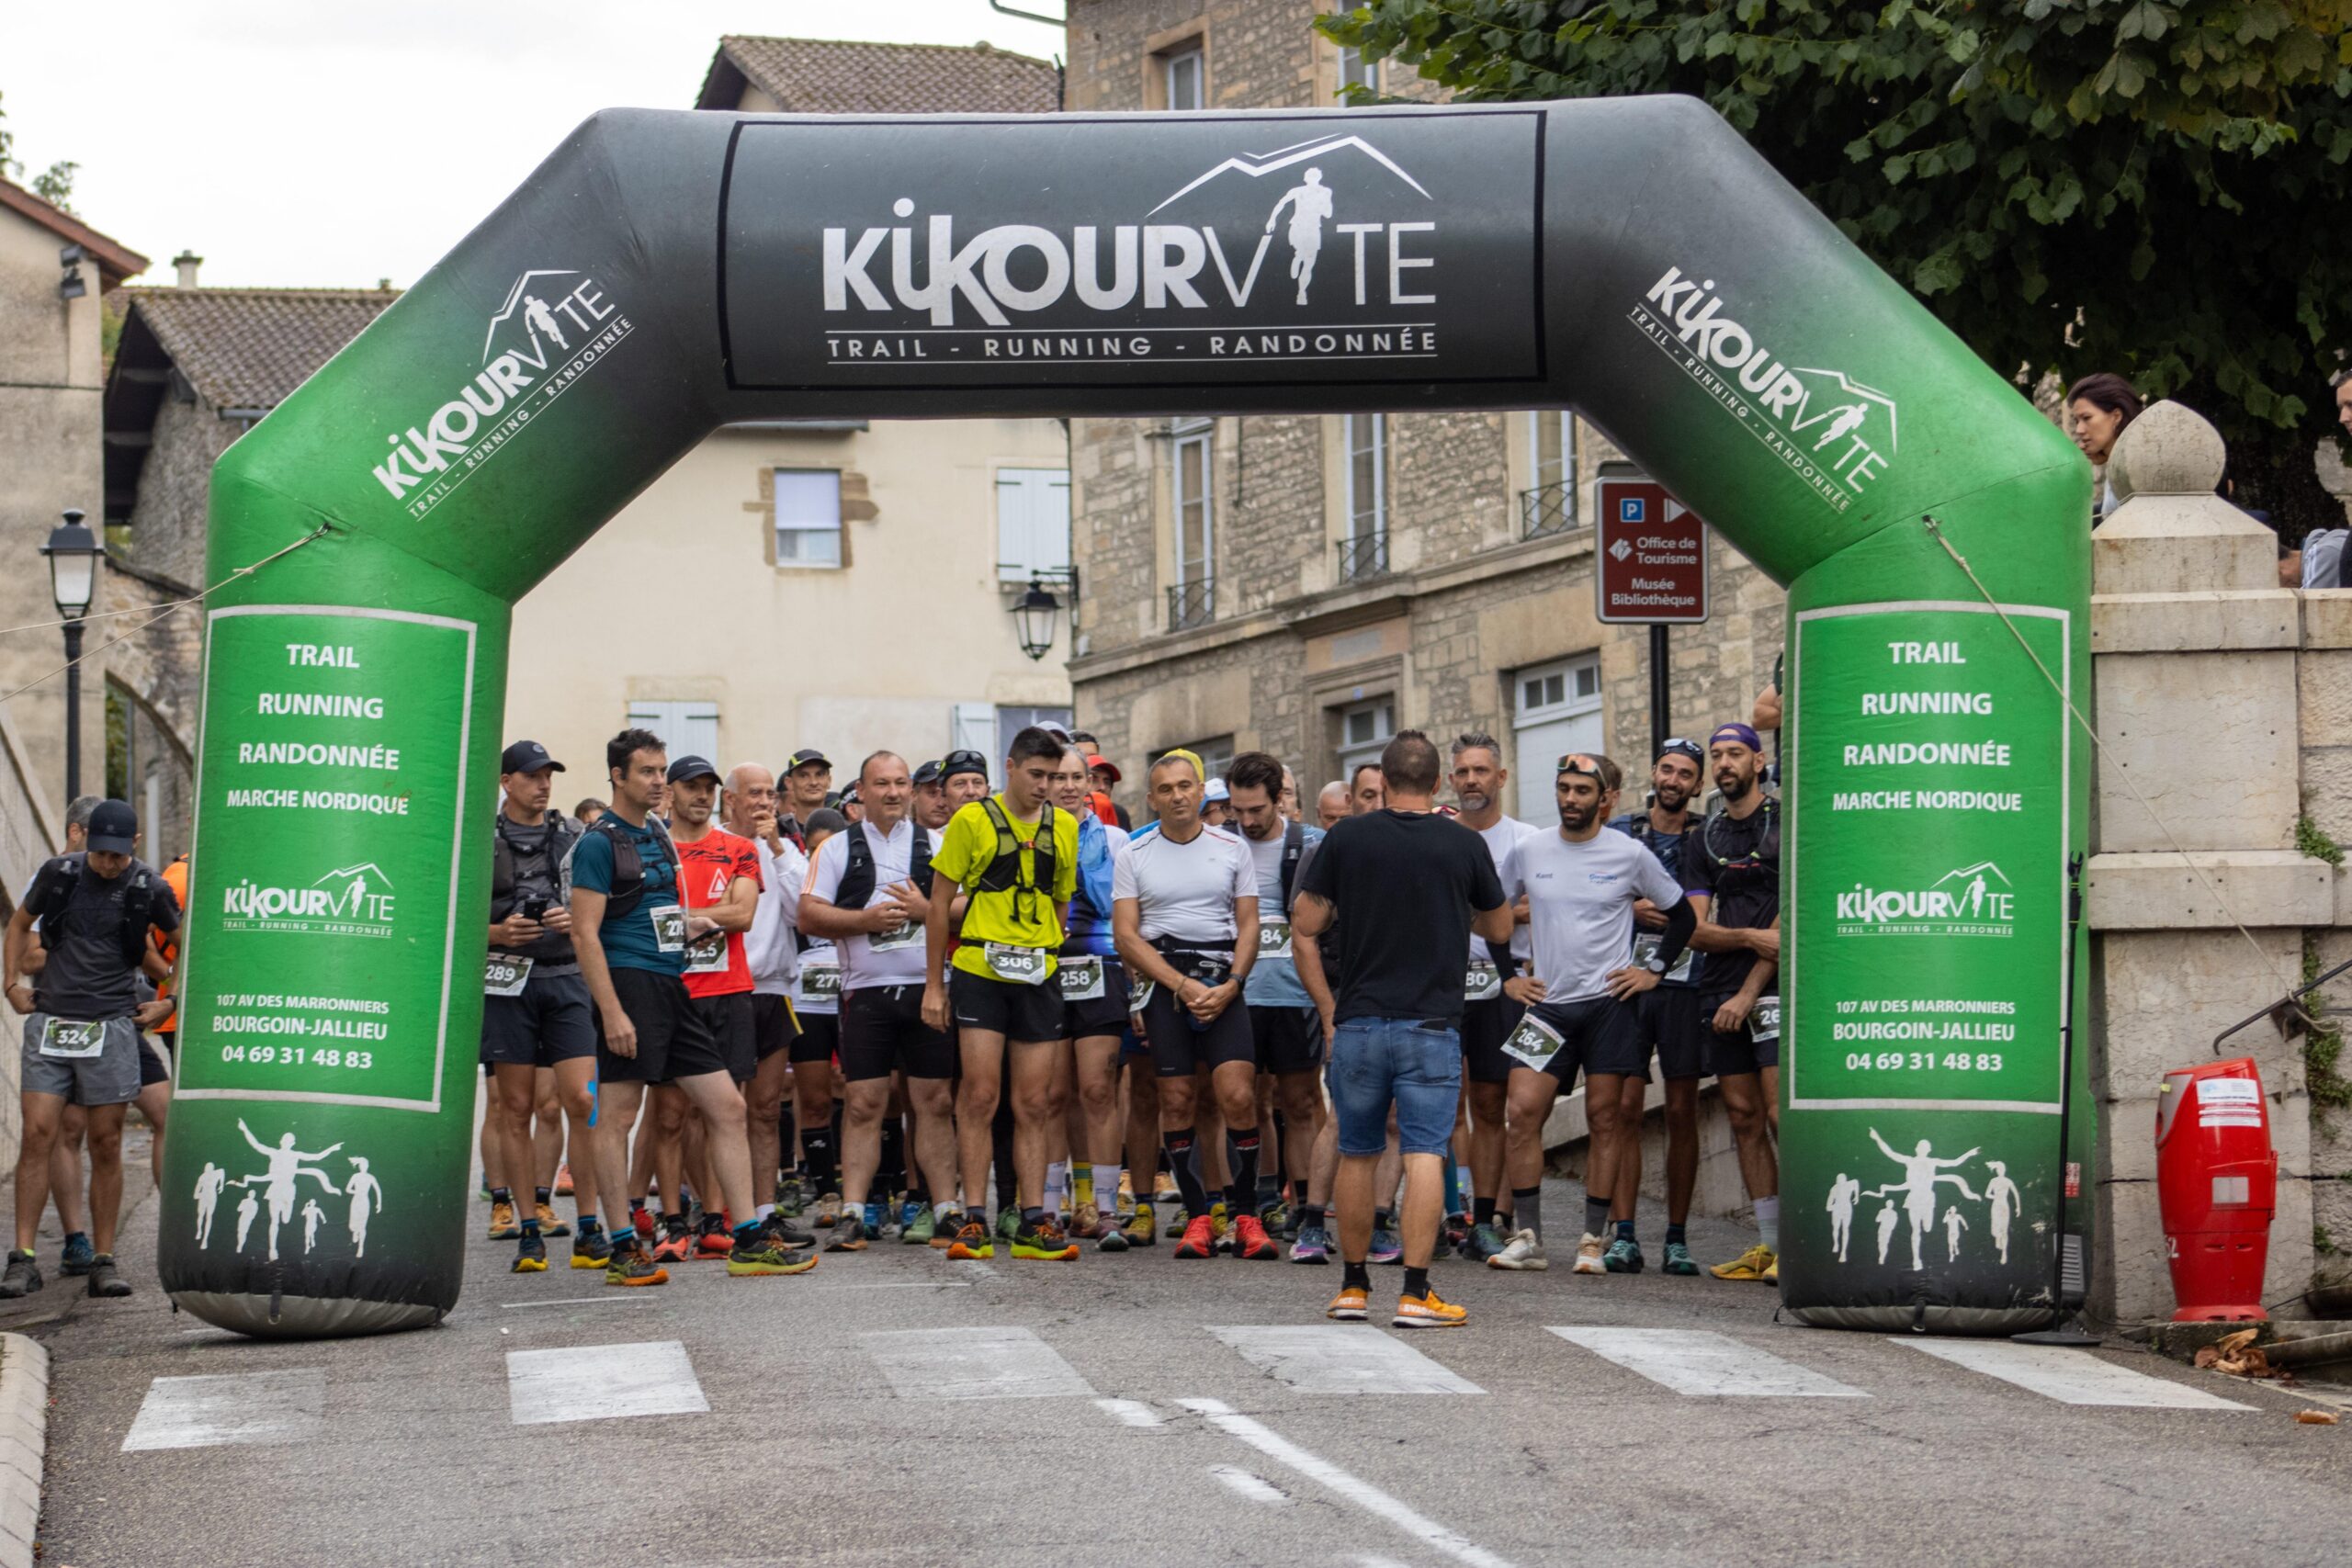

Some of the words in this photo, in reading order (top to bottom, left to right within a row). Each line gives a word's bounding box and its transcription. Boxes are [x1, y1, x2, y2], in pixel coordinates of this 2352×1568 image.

[827, 337, 927, 358] TRAIL
[984, 335, 1151, 357] RUNNING
[1210, 328, 1437, 355] RANDONNÉE
[409, 481, 451, 518] TRAIL
[464, 409, 530, 468] RUNNING
[545, 317, 633, 397] RANDONNÉE
[1630, 306, 1668, 346] TRAIL
[1684, 357, 1749, 418] RUNNING
[1764, 431, 1850, 512] RANDONNÉE
[1626, 503, 1638, 518] P
[1636, 536, 1677, 549] Office
[1678, 536, 1697, 549] de
[1635, 552, 1697, 565] Tourisme
[1631, 577, 1676, 591] Musée
[1611, 592, 1696, 608] Bibliothèque
[286, 644, 360, 669] TRAIL
[1887, 641, 1967, 664] TRAIL
[257, 693, 384, 719] RUNNING
[1861, 693, 1993, 716] RUNNING
[238, 742, 401, 771] RANDONNÉE
[1843, 739, 2011, 766] RANDONNÉE
[226, 789, 299, 808] MARCHE
[301, 791, 409, 816] NORDIQUE
[1832, 791, 1912, 811] MARCHE
[1916, 791, 2022, 813] NORDIQUE
[259, 921, 309, 931] RUNNING
[1878, 925, 1930, 934] RUNNING
[484, 964, 516, 982] 289
[998, 955, 1034, 971] 306
[1059, 970, 1090, 987] 258
[216, 994, 236, 1007] 107
[237, 995, 256, 1007] AV
[256, 995, 284, 1009] DES
[285, 996, 390, 1015] MARRONNIERS
[1836, 1001, 1859, 1014] 107
[1860, 1000, 1880, 1013] AV
[1881, 1000, 1909, 1013] DES
[1911, 999, 2017, 1015] MARRONNIERS
[56, 1029, 91, 1045] 324
[212, 1015, 389, 1041] BOURGOIN-JALLIEU
[1833, 1022, 2016, 1042] BOURGOIN-JALLIEU
[1516, 1027, 1545, 1052] 264
[220, 1045, 245, 1063] 04
[248, 1045, 276, 1064] 69
[278, 1047, 305, 1065] 31
[311, 1049, 341, 1067] 48
[344, 1051, 373, 1069] 83
[1845, 1053, 1871, 1070] 04
[1875, 1053, 1905, 1070] 69
[1908, 1052, 1935, 1070] 31
[1942, 1053, 1972, 1070] 48
[1975, 1053, 2003, 1072] 83
